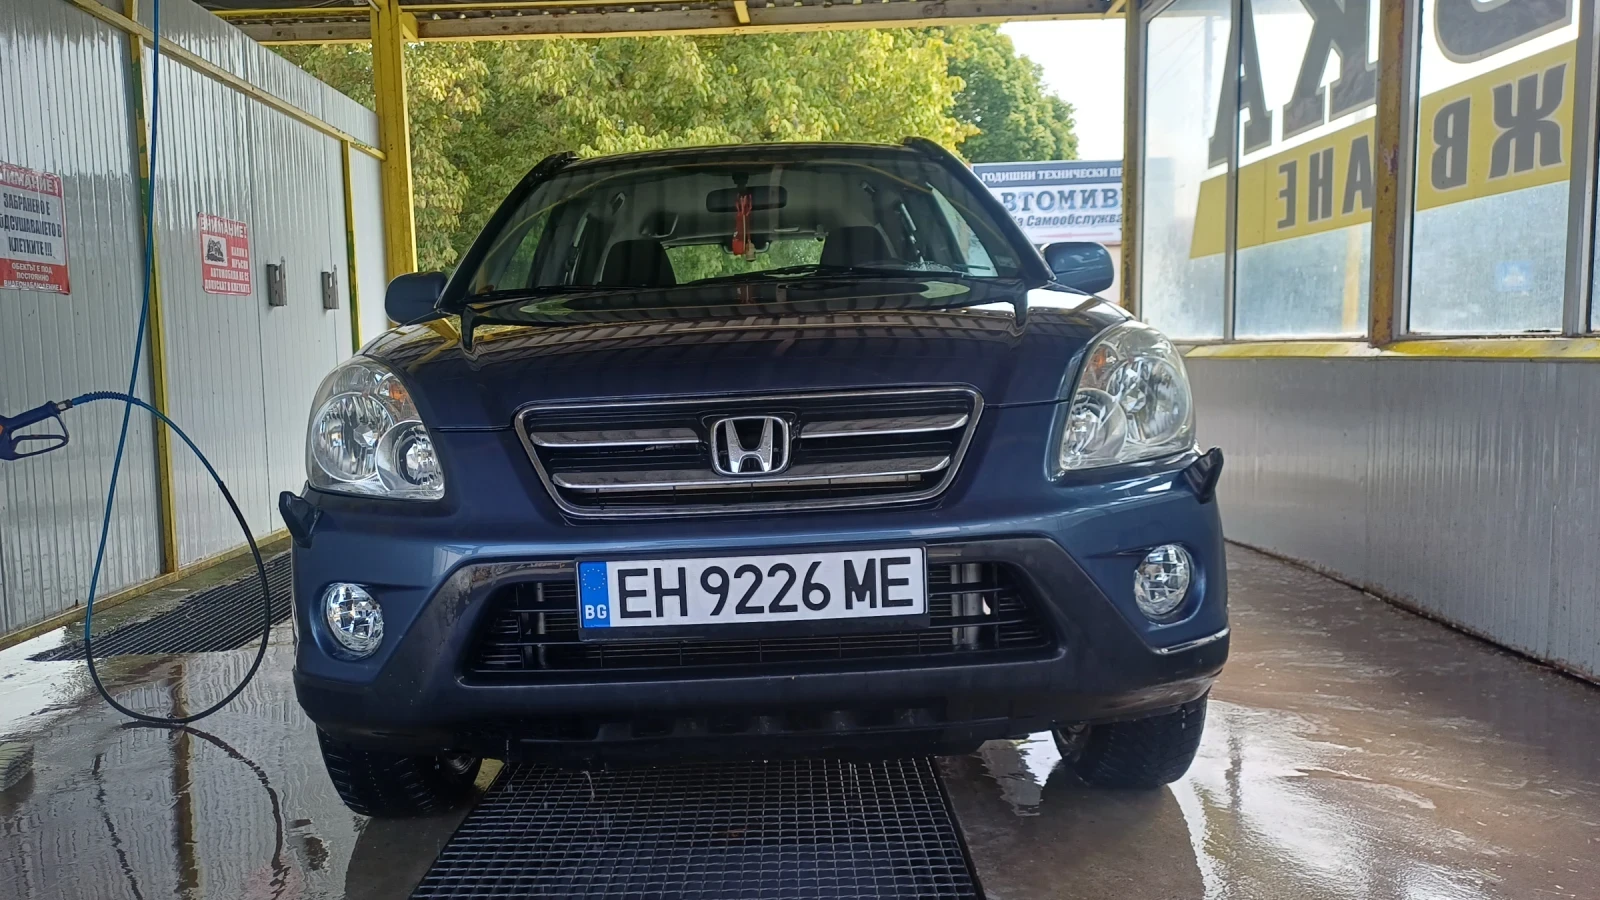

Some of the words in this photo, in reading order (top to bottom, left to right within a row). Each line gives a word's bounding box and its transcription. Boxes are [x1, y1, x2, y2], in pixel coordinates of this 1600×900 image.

[982, 170, 1036, 183] ГОДИШНИ
[1037, 167, 1108, 181] ТЕХНИЧЕСКИ
[3, 192, 45, 215] ЗАБРАНЕНО
[46, 200, 51, 216] Е
[1001, 188, 1122, 212] ВТОМИВ
[617, 566, 689, 619] EH
[699, 560, 831, 617] 9226
[843, 556, 914, 610] ME
[584, 604, 607, 619] BG
